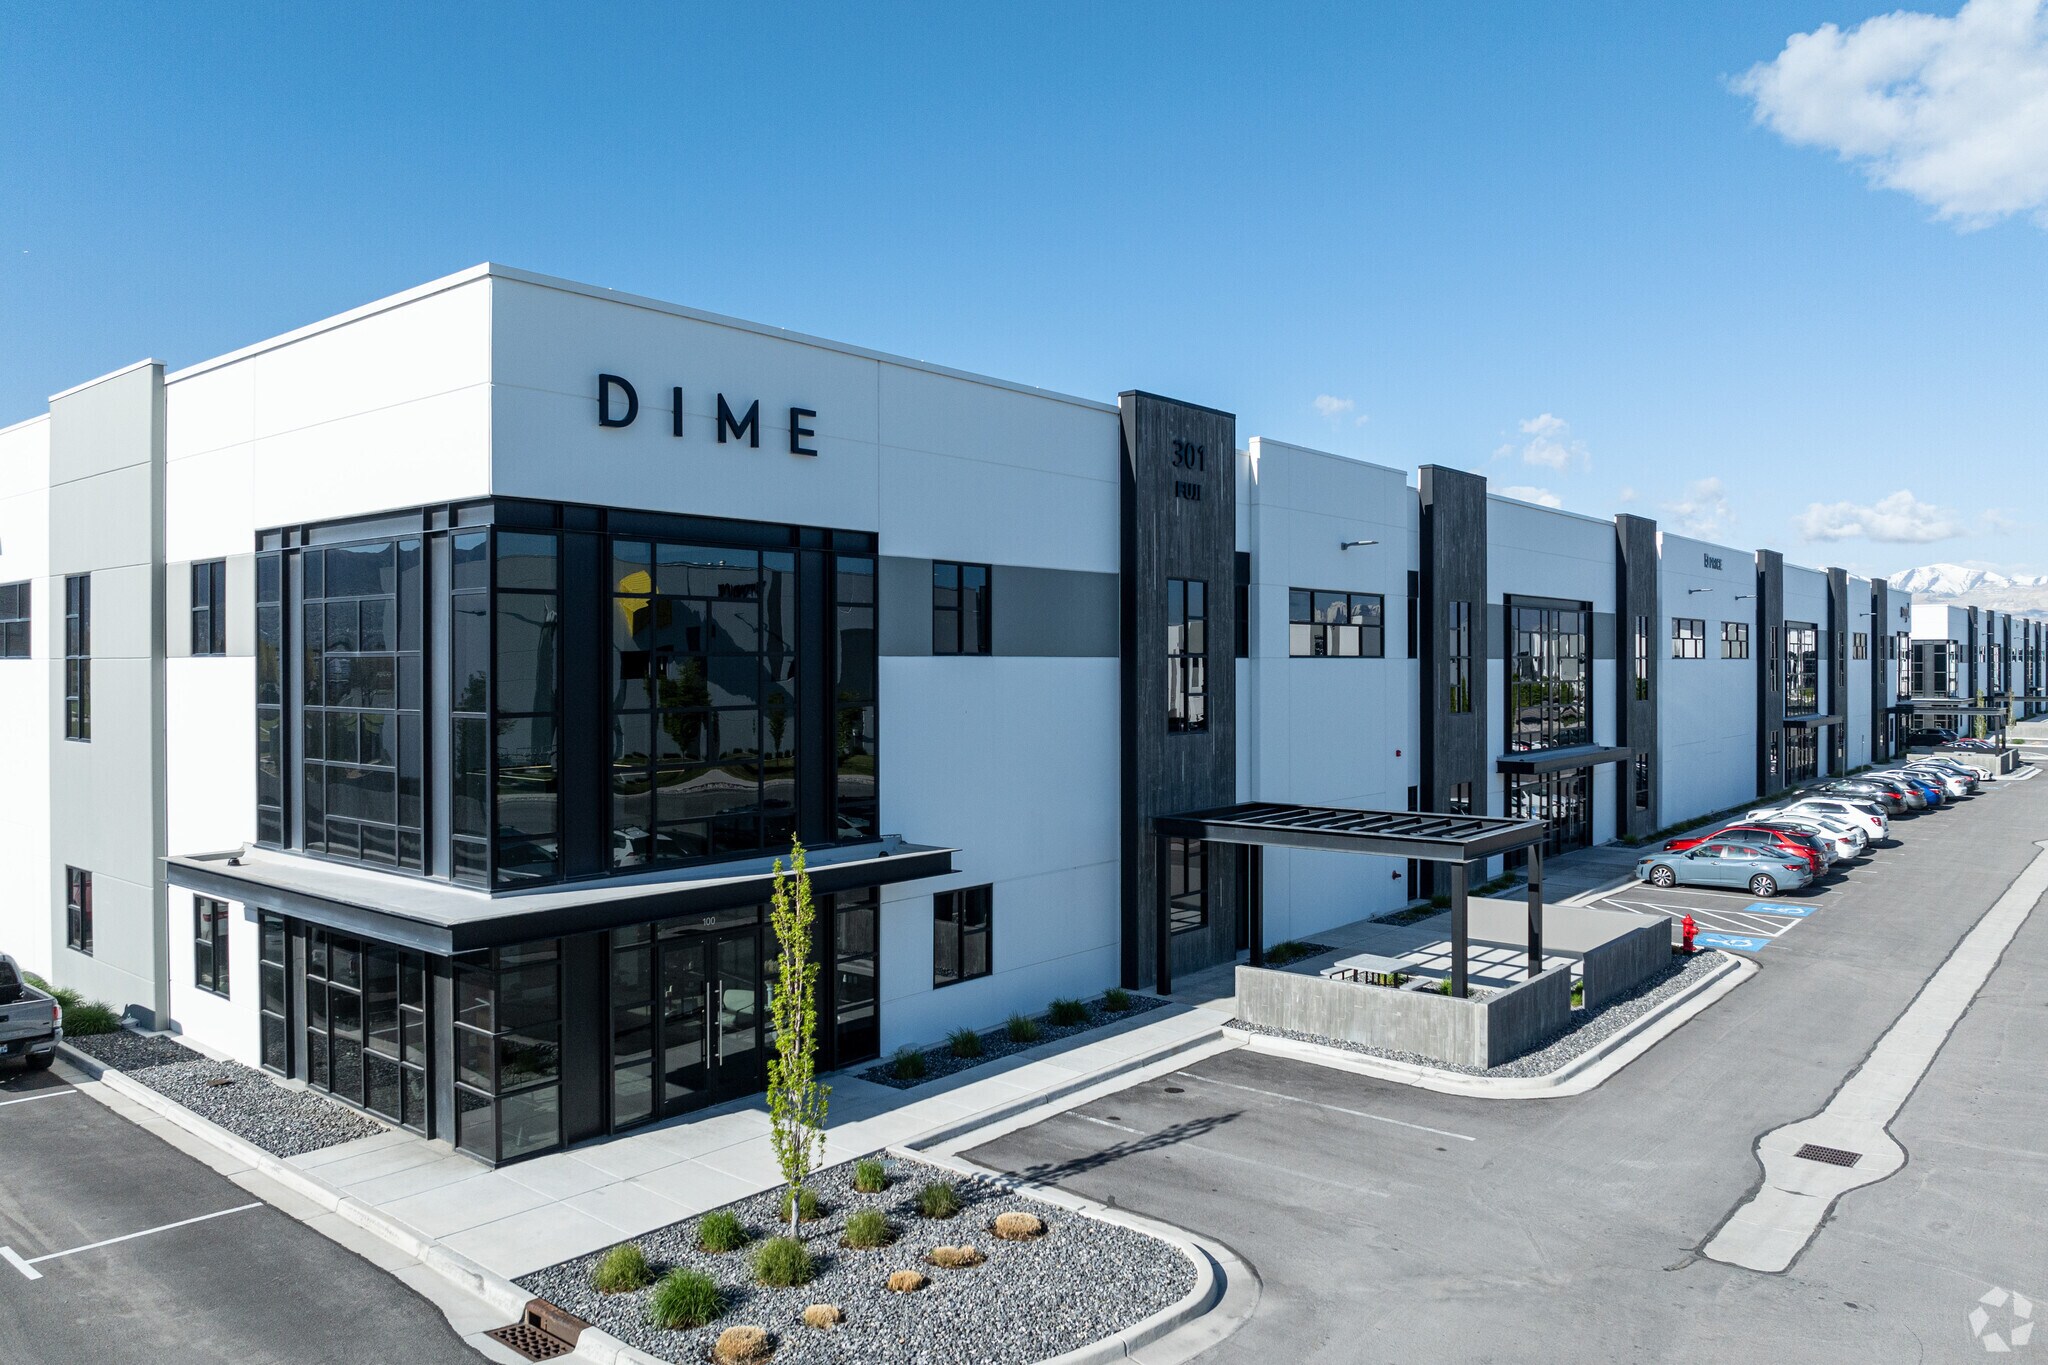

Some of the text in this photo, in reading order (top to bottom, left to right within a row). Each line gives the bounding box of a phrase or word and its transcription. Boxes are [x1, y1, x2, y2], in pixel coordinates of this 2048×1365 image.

[598, 373, 818, 457] DIME
[1172, 440, 1204, 472] 301
[702, 916, 716, 926] 100
